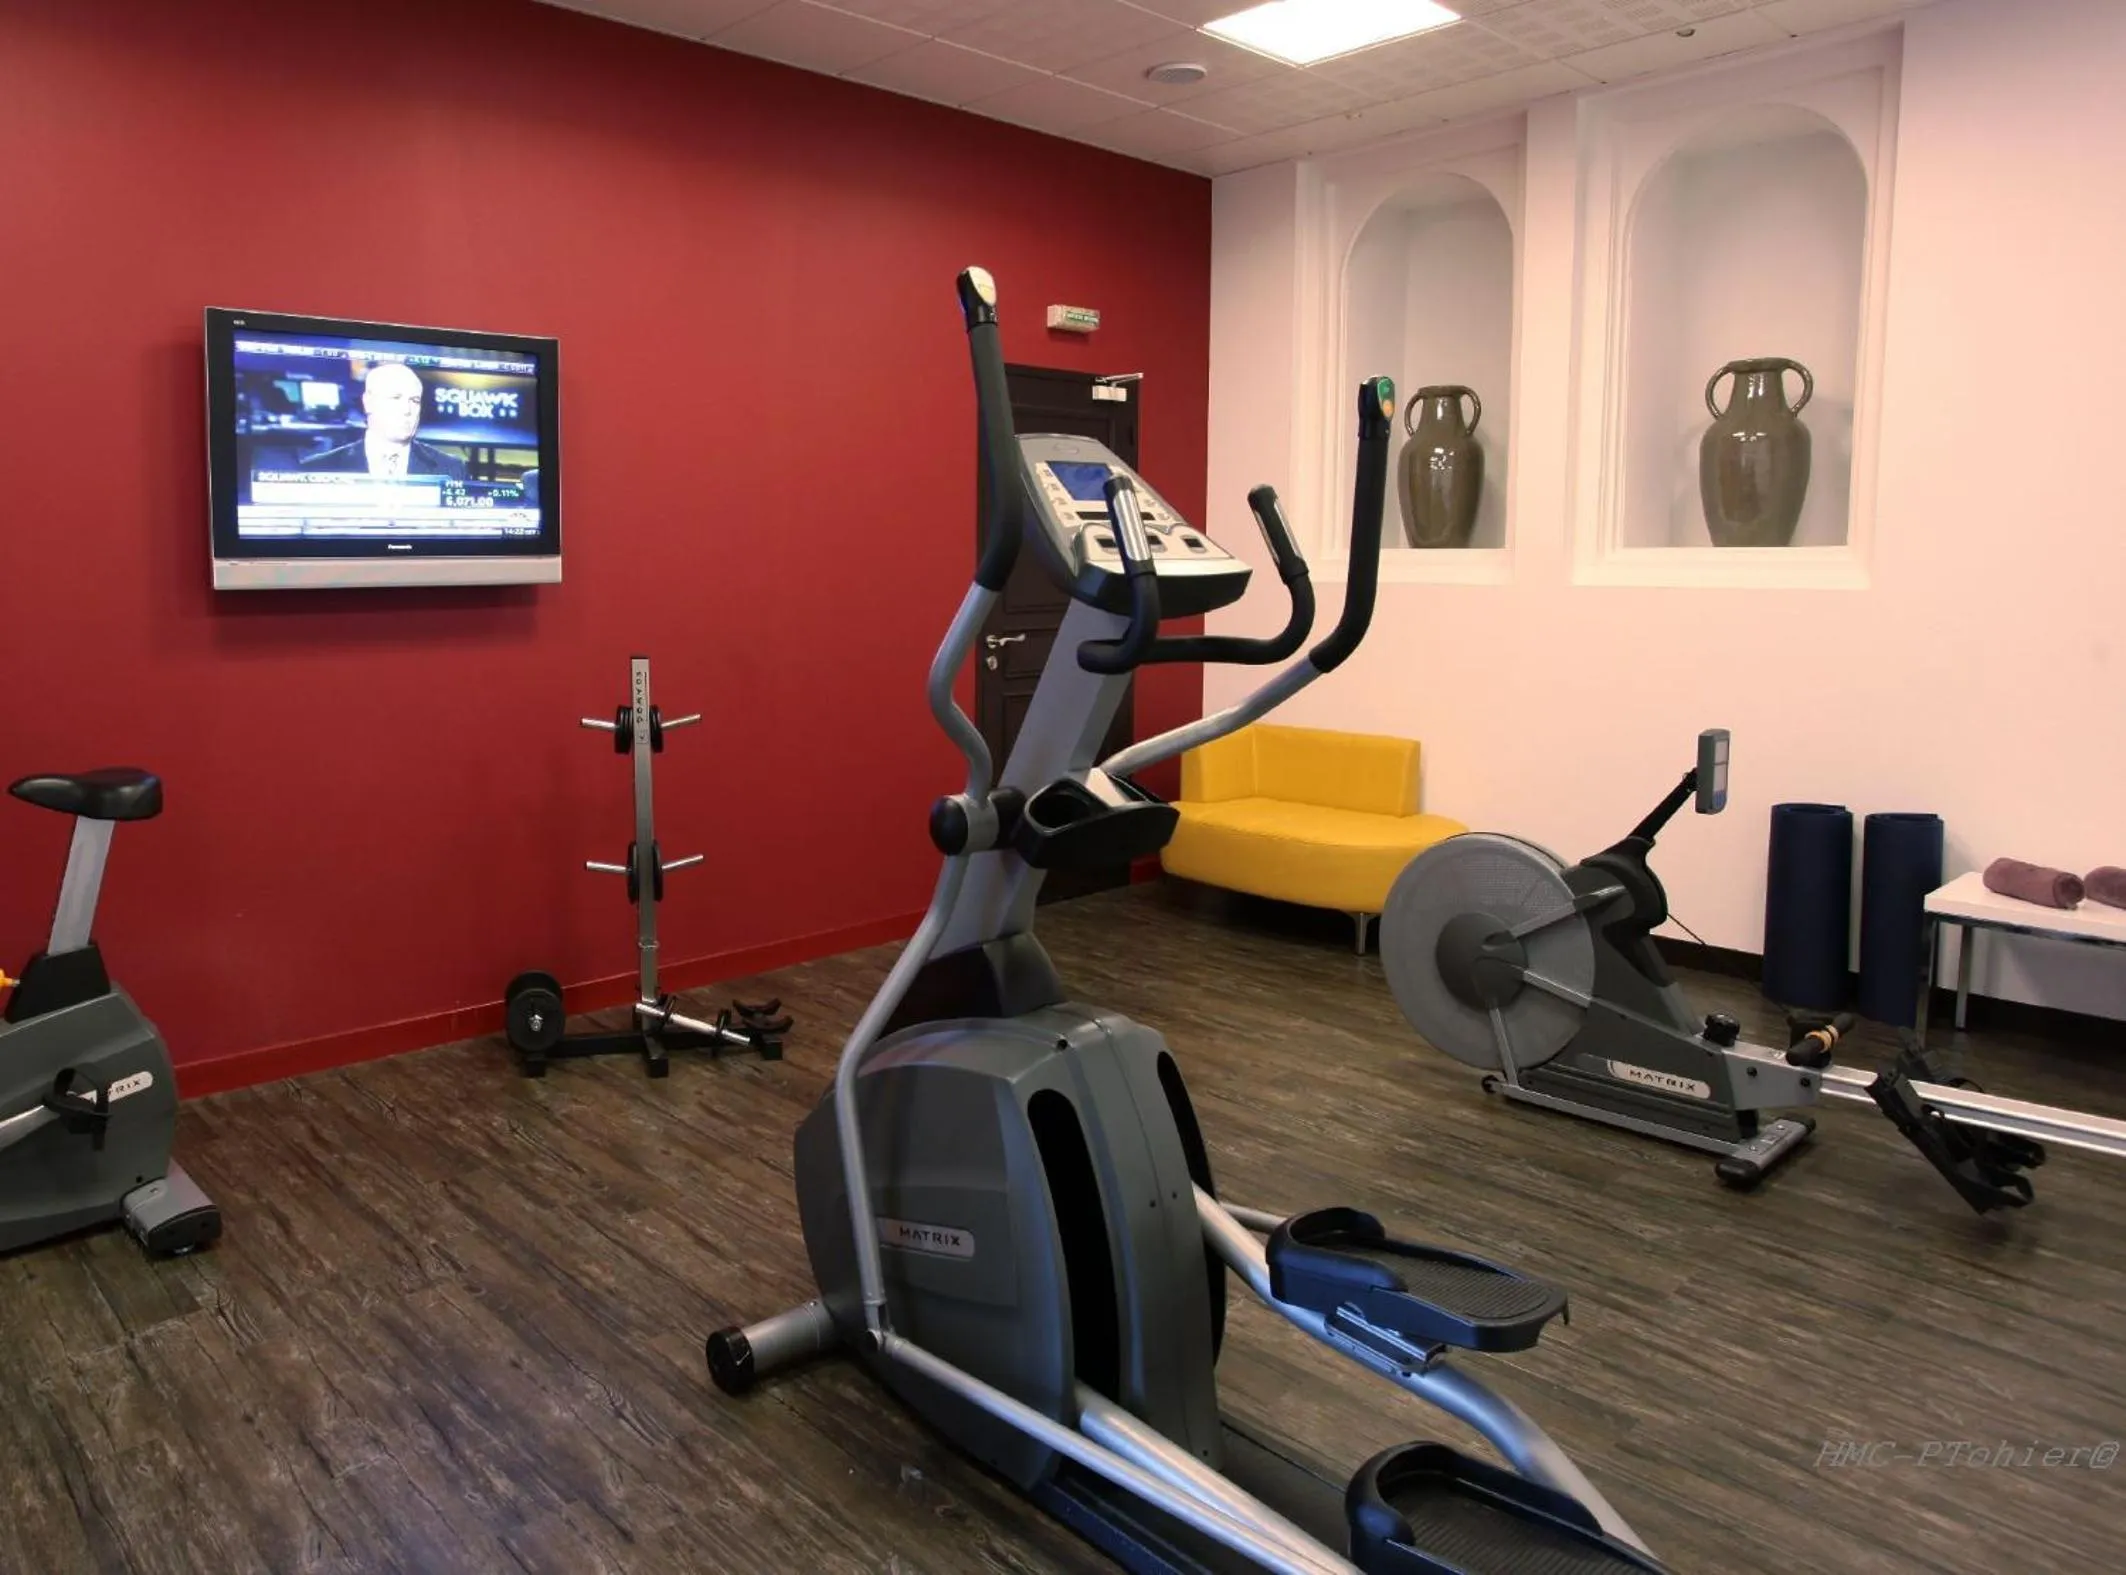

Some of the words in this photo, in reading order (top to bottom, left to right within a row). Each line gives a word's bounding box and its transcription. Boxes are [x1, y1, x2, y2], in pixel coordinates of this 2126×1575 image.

[435, 387, 518, 408] SQUAWK
[459, 401, 494, 418] BOX
[1629, 1069, 1695, 1092] MATRIX
[899, 1226, 960, 1246] MATRIX
